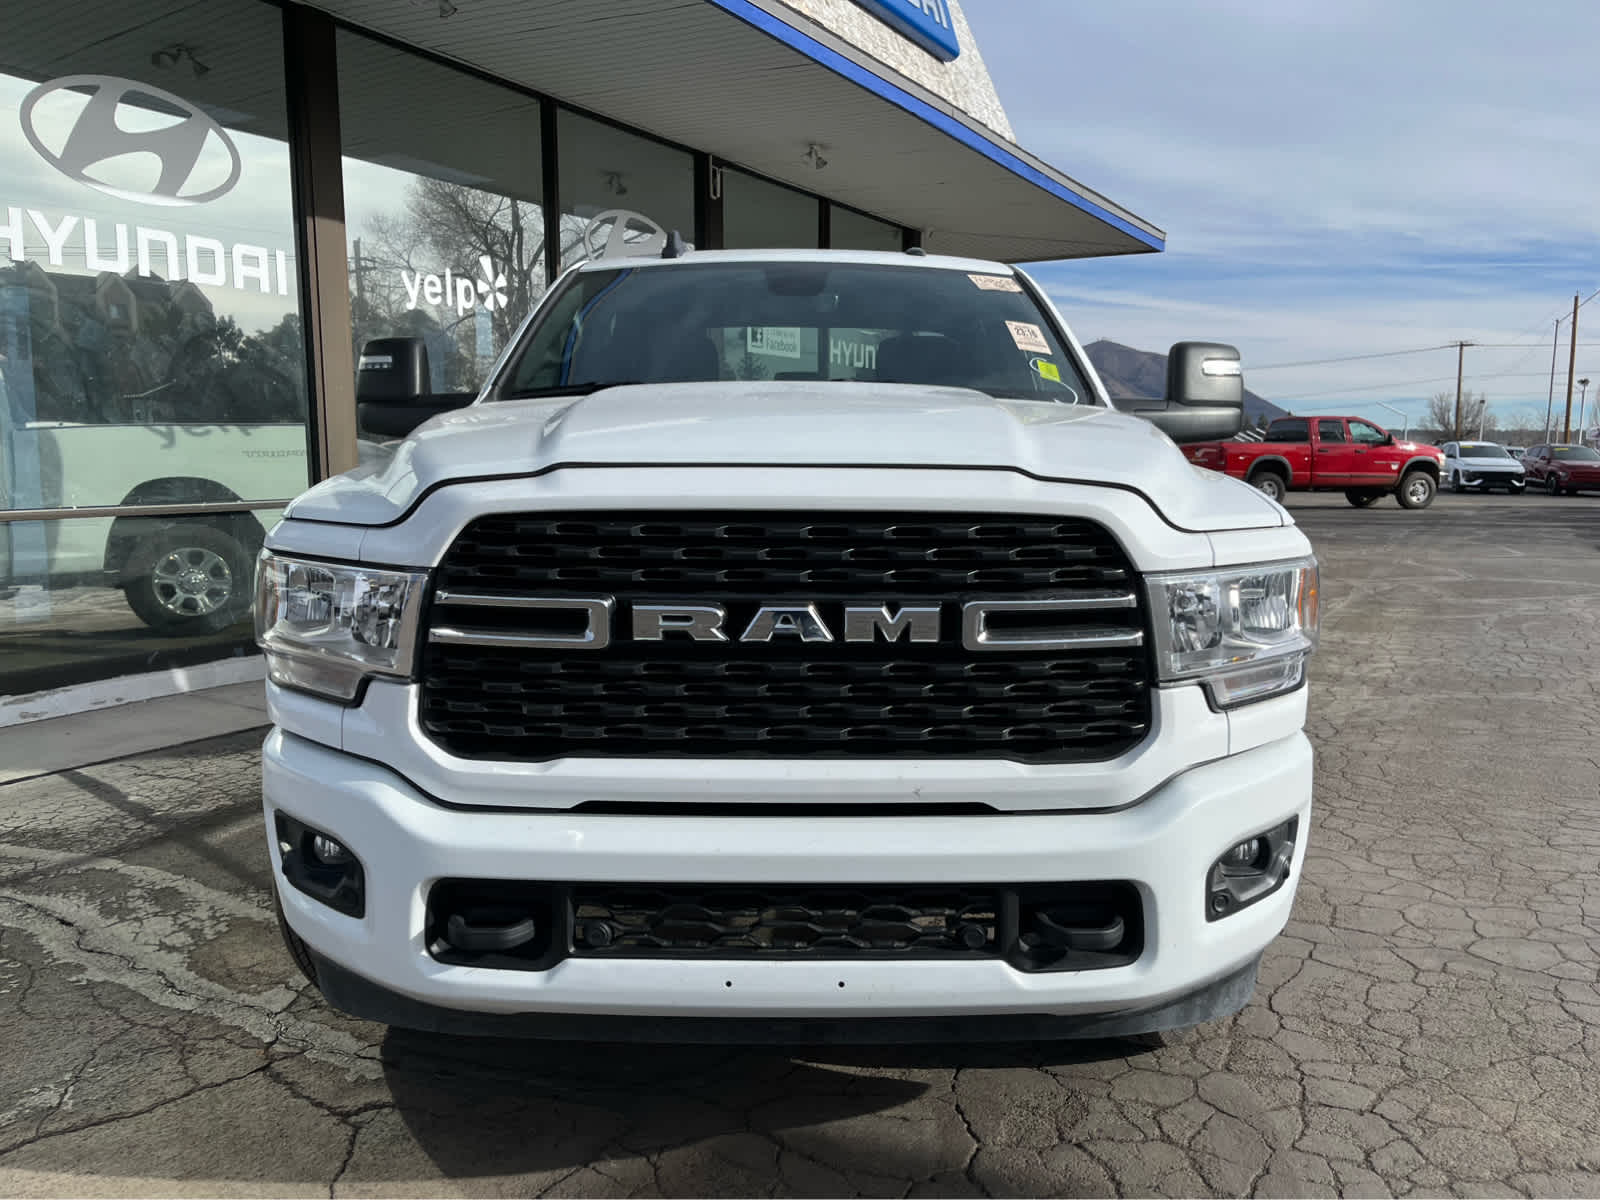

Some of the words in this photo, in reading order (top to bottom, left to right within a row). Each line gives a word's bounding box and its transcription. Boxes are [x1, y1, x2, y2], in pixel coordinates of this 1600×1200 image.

[401, 267, 475, 317] yelp
[829, 338, 879, 370] HYUN
[632, 604, 941, 643] RAM
